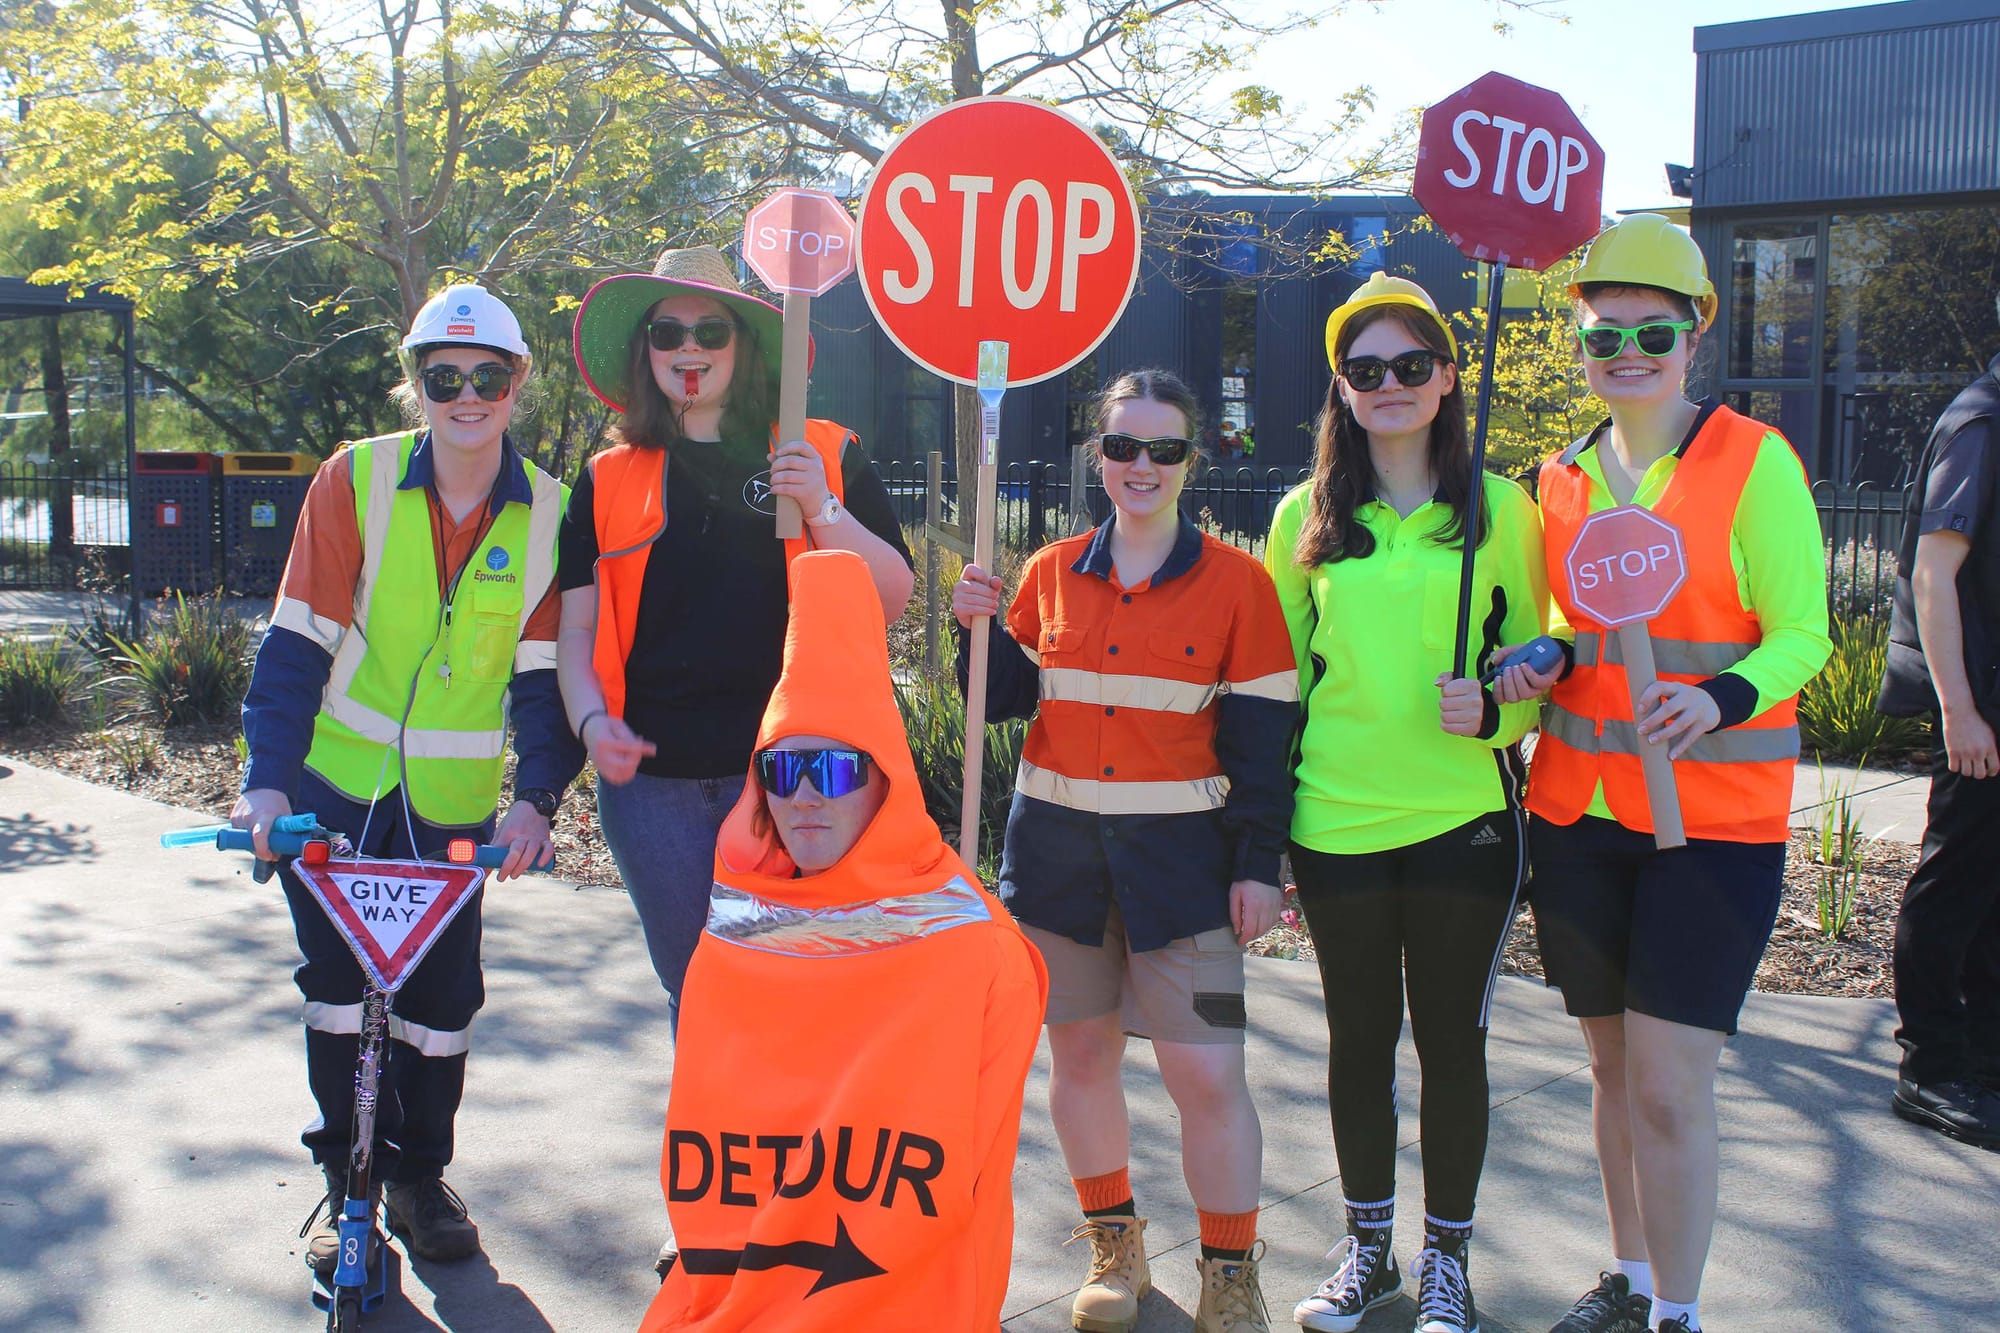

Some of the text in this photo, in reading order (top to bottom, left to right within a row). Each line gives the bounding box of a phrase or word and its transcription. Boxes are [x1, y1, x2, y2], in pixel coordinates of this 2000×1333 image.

[1443, 109, 1589, 213] STOP
[757, 226, 845, 257] STOP
[882, 172, 1116, 313] STOP
[474, 569, 516, 584] Epworth
[1579, 544, 1671, 589] STOP
[350, 880, 427, 905] GIVE
[362, 905, 415, 923] WAY
[668, 1126, 945, 1218] DETOUR
